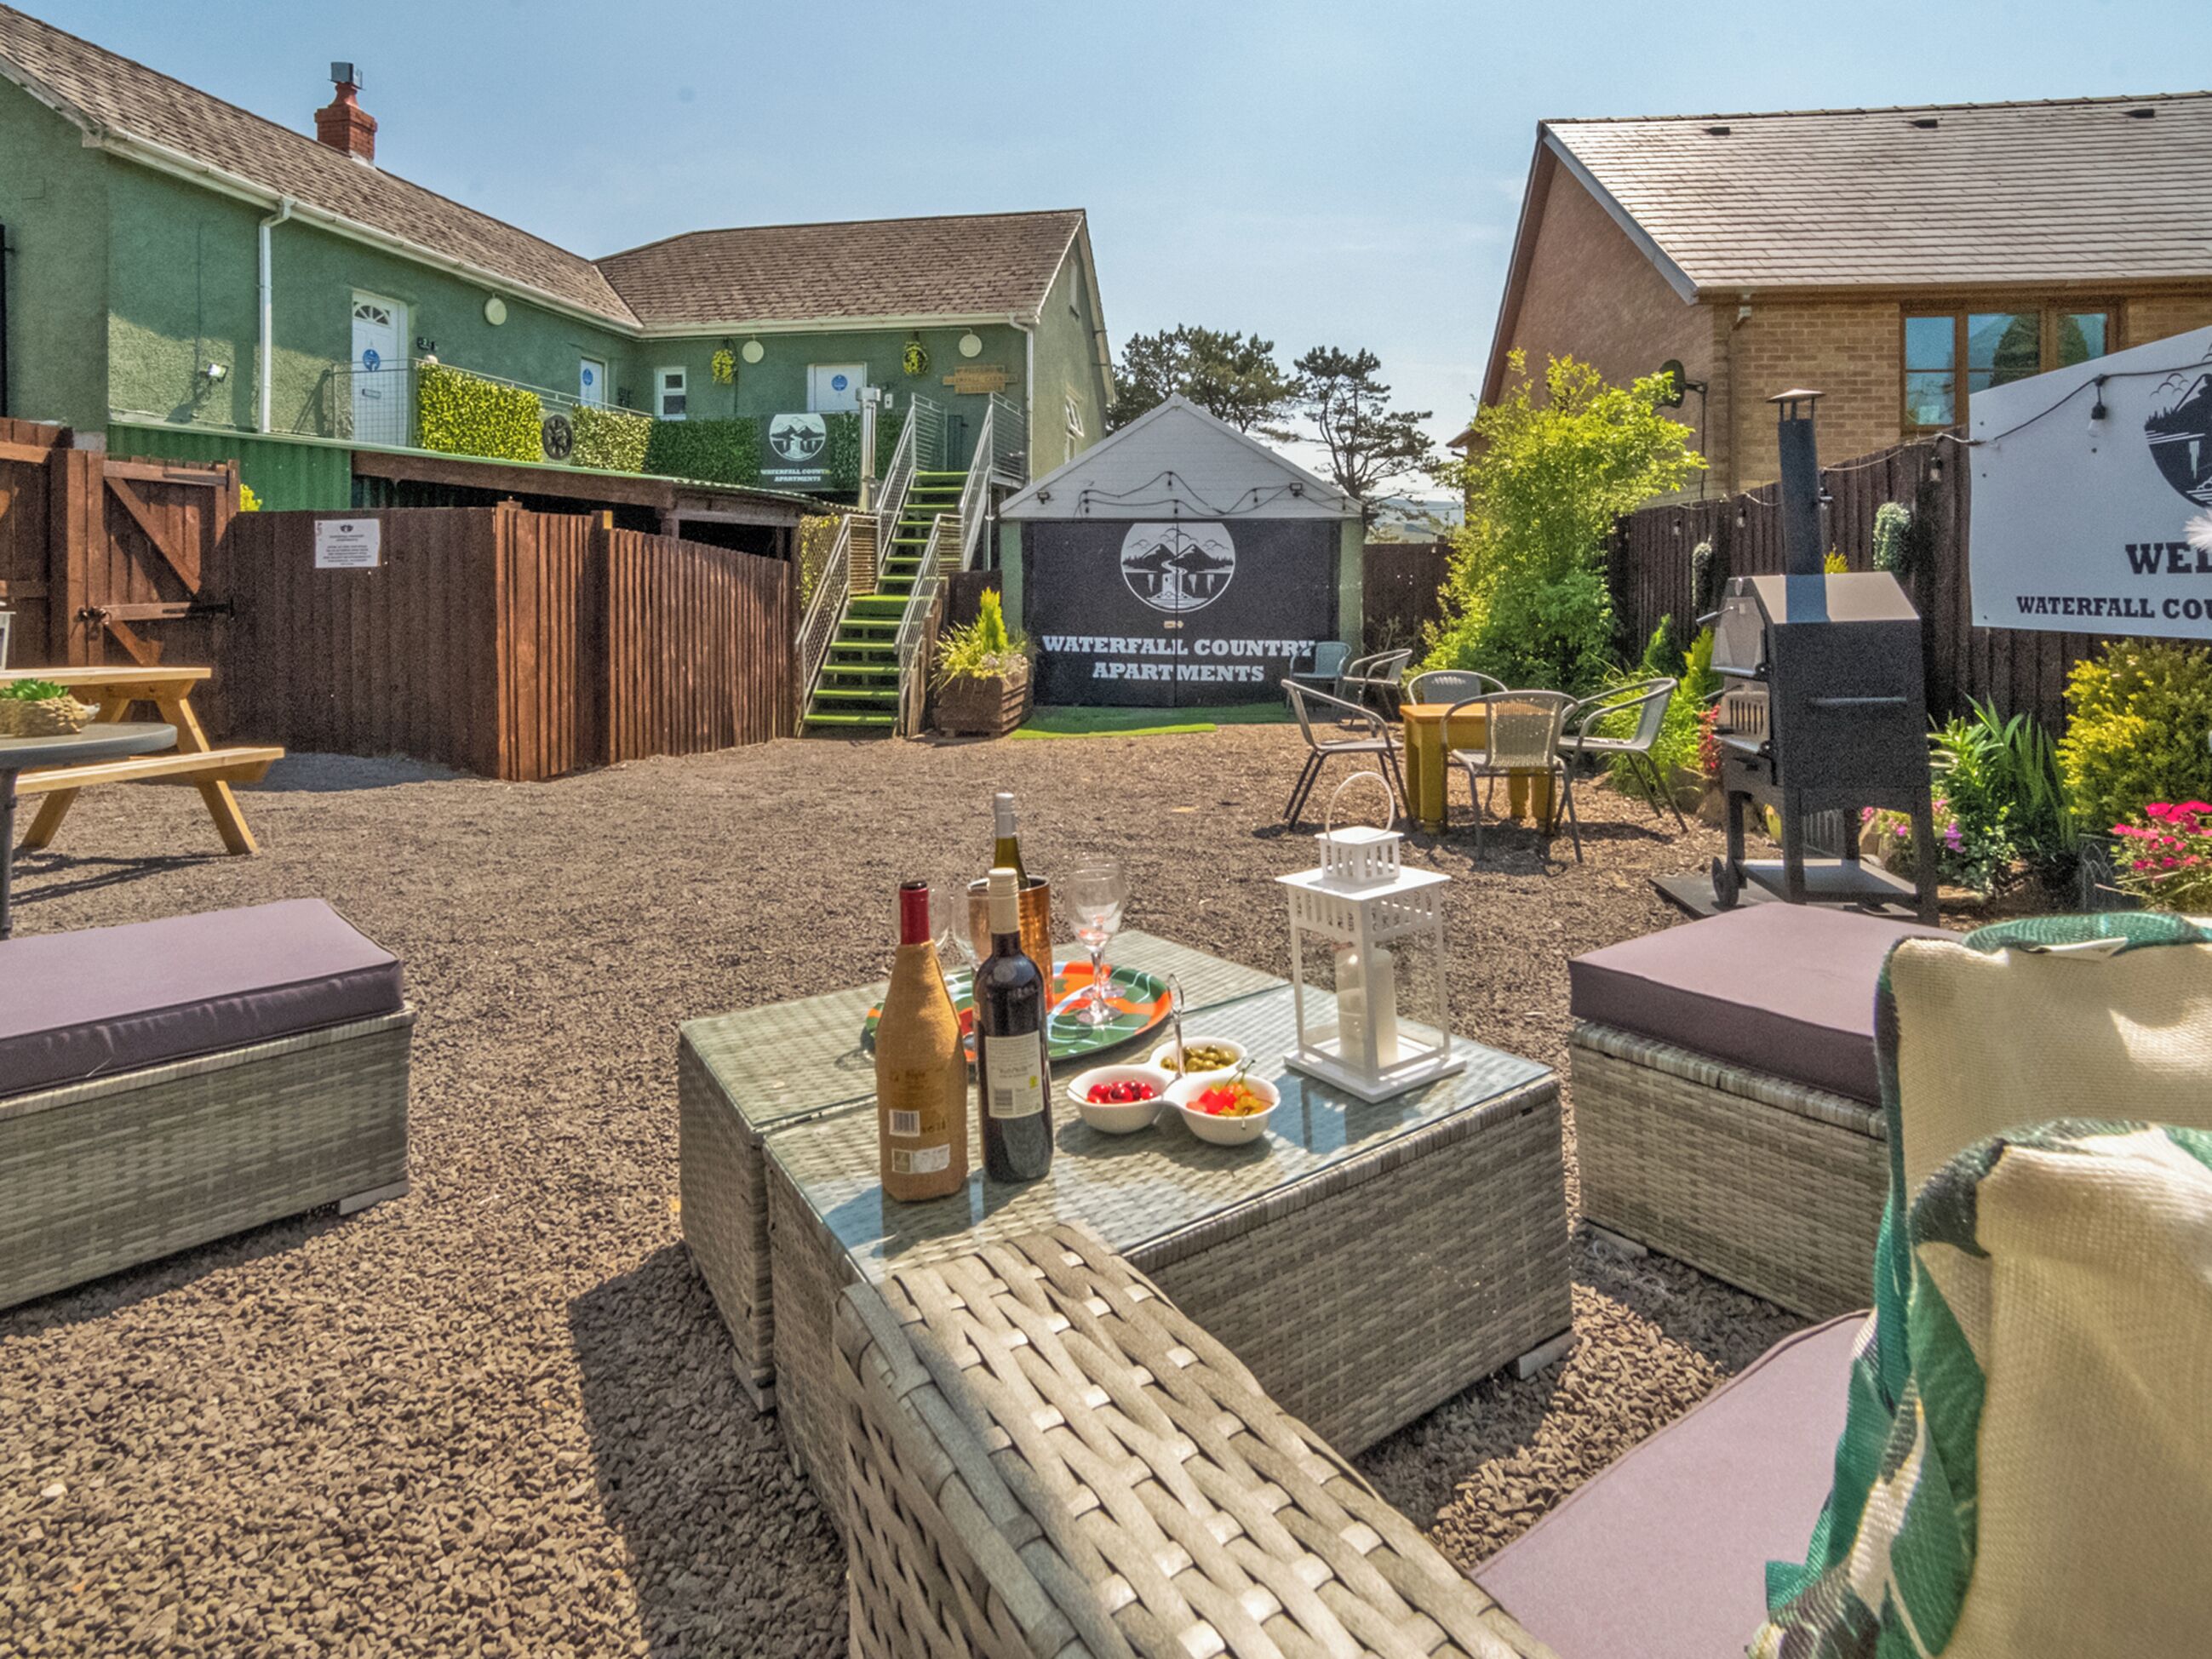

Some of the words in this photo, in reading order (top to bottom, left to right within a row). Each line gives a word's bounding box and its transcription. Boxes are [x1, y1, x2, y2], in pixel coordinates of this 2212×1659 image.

[2016, 596, 2155, 618] WATERFALL
[1042, 636, 1188, 655] WATERFALL
[1194, 639, 1315, 656] COUNTRY
[1092, 662, 1264, 681] APARTMENTS
